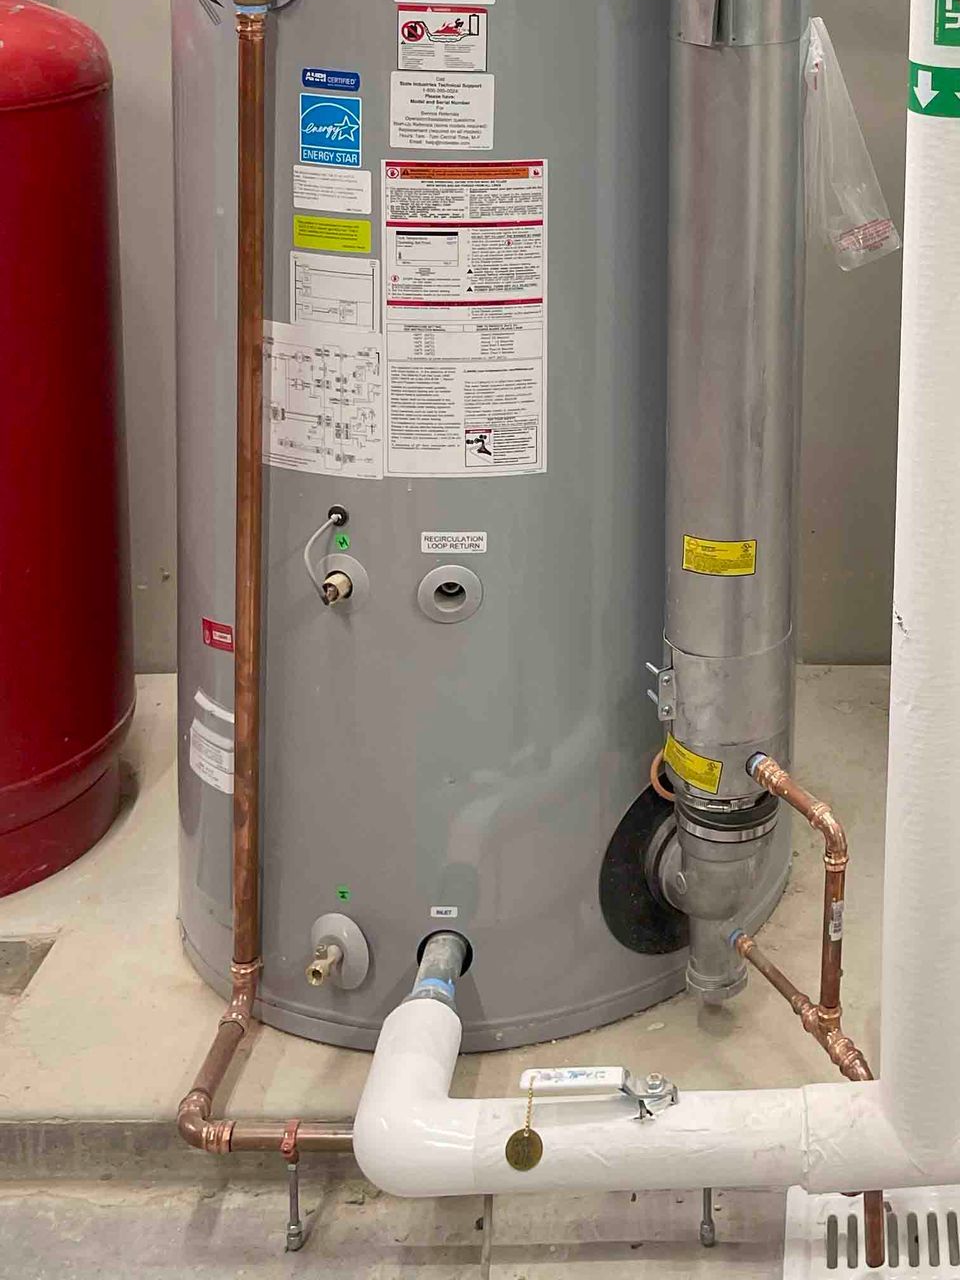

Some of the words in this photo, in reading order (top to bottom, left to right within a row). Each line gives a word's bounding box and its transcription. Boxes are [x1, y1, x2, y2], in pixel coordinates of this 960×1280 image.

[327, 76, 356, 85] CERTIFIED
[305, 123, 339, 140] energy
[303, 151, 334, 162] ENERGY
[336, 153, 357, 163] STAR
